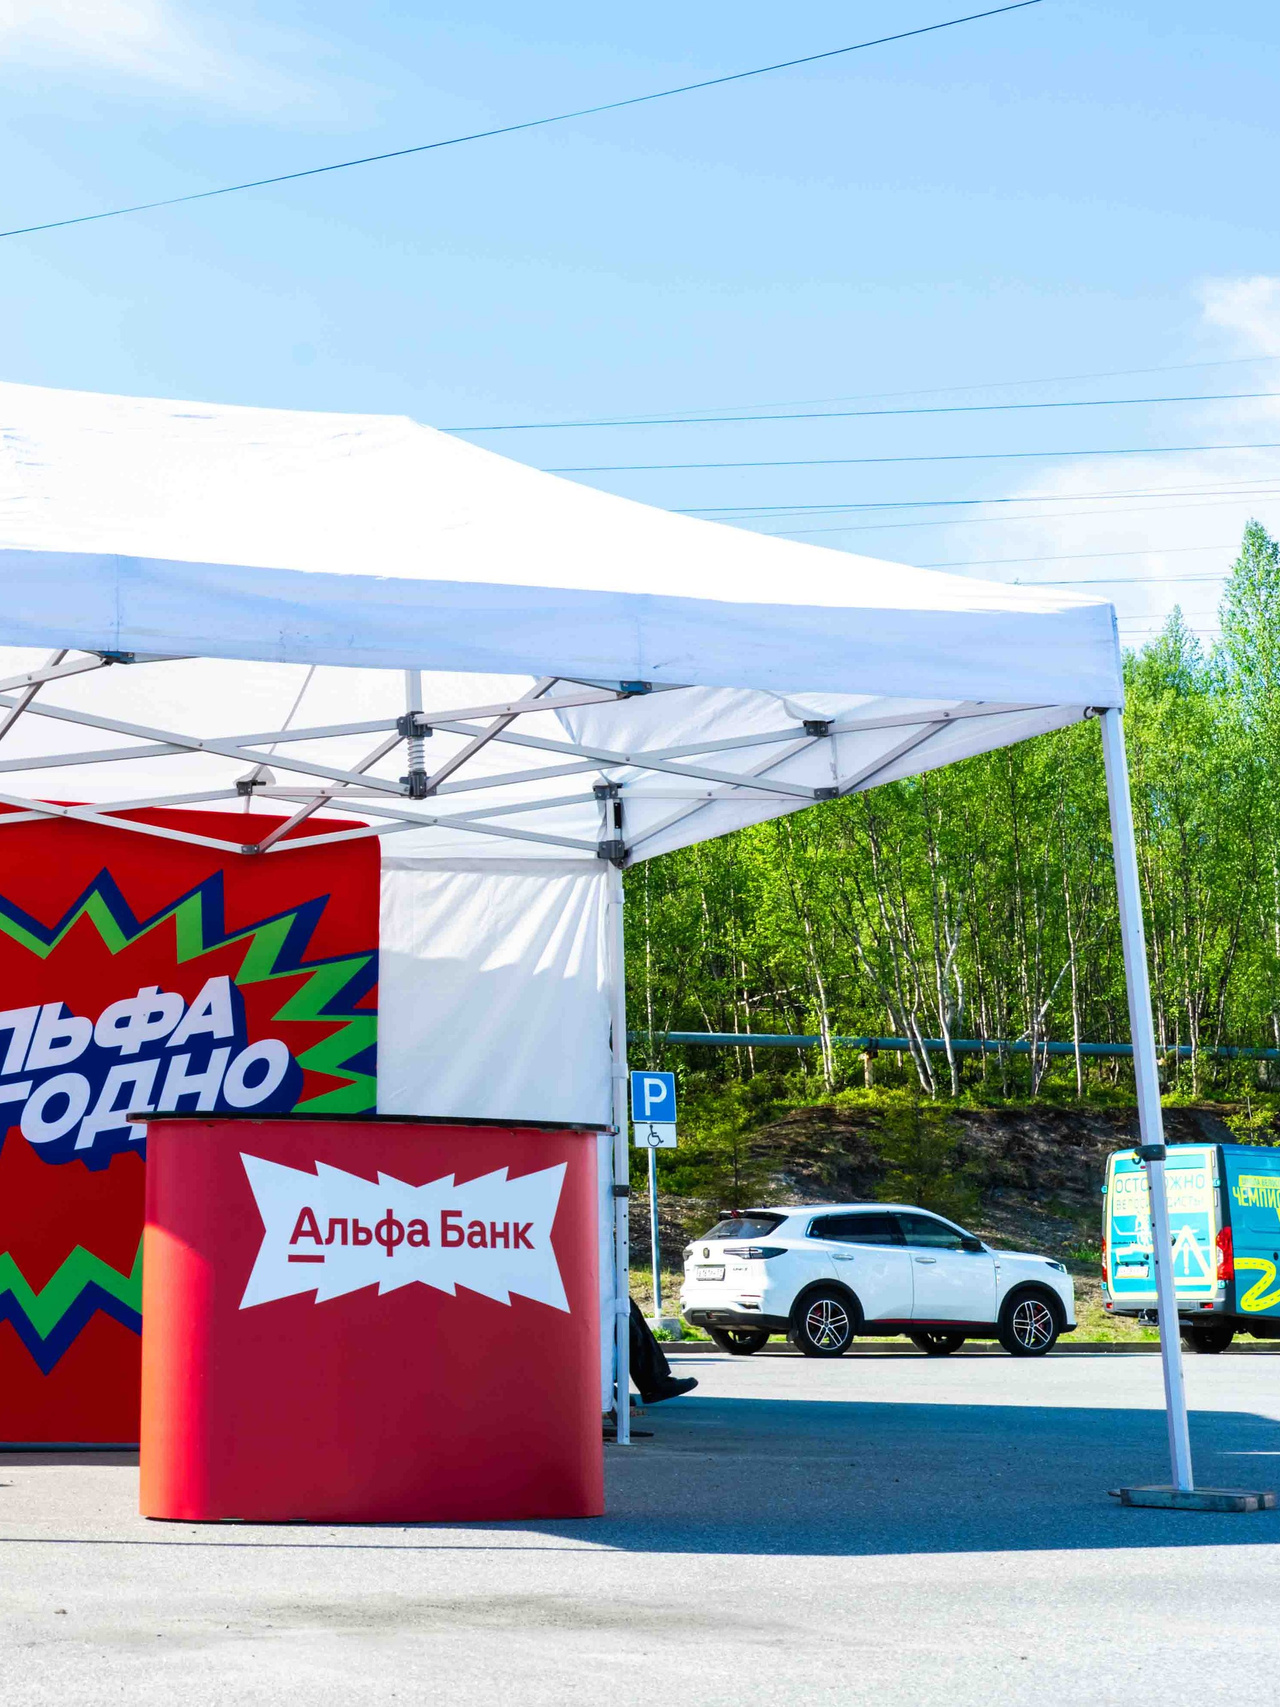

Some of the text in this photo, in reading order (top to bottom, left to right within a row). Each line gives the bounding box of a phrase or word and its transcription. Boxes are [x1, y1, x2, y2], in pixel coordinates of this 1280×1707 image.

[644, 1078, 667, 1116] P
[1115, 1173, 1205, 1193] ОСТОЖНО
[287, 1206, 535, 1263] Альфа Банк
